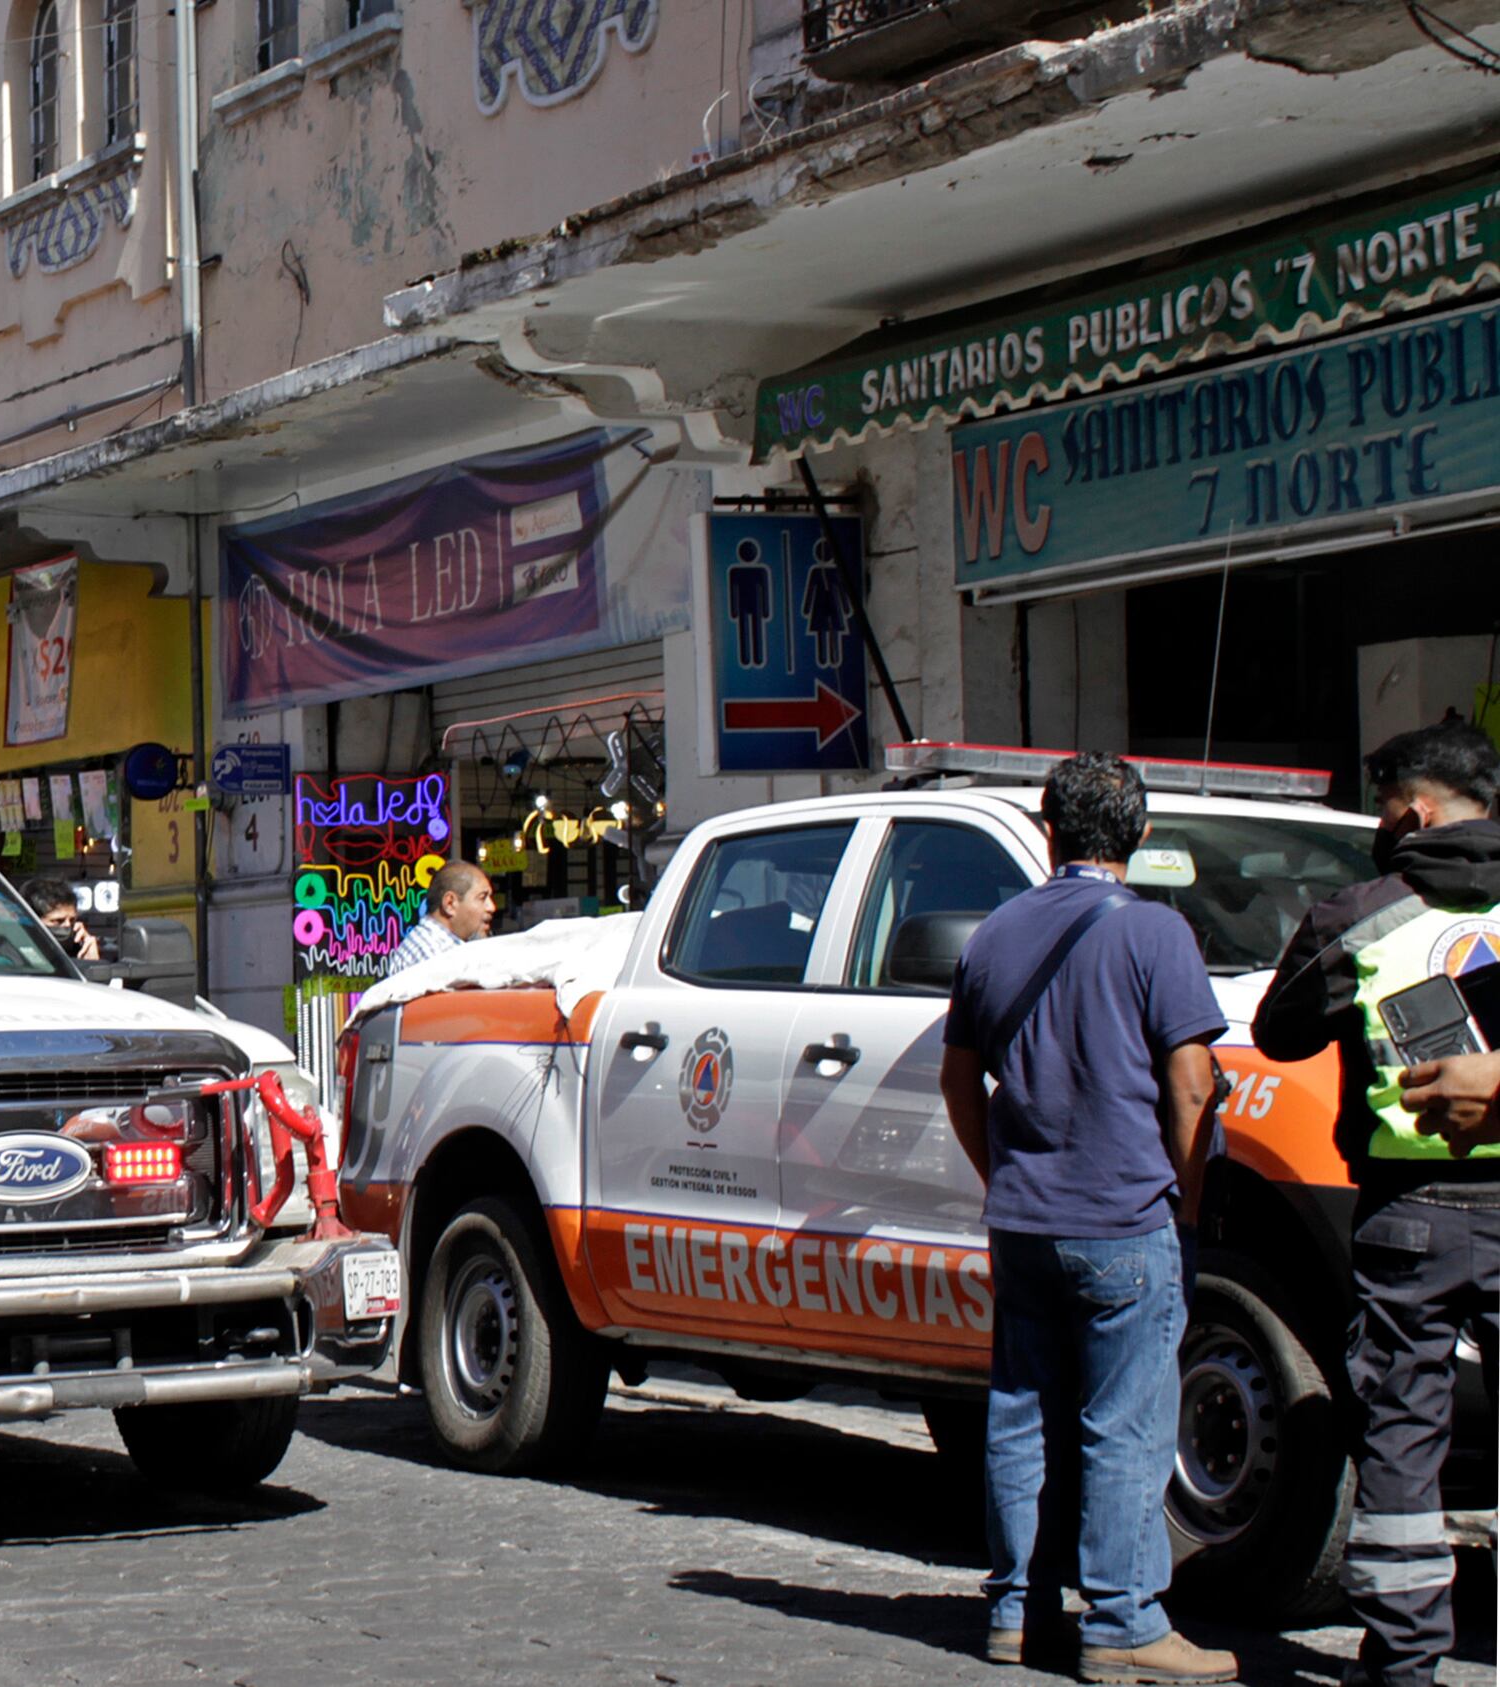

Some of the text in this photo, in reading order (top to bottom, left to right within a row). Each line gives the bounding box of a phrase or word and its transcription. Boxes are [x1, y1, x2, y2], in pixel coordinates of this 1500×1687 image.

[861, 326, 1044, 415] SANITARIOS
[1068, 268, 1254, 363] PUBLICOS
[777, 385, 825, 435] WC
[1061, 353, 1327, 486] SANITARIOS
[953, 431, 1050, 564] WC
[1188, 466, 1219, 537] 7
[286, 553, 384, 648] HOLA
[409, 527, 483, 623] LED
[168, 820, 181, 865] 3
[245, 812, 260, 852] 4
[681, 1181, 714, 1194] INTEGRAL
[716, 1184, 725, 1195] DE
[726, 1185, 758, 1198] RIESGOS
[712, 1169, 731, 1182] CIVIL
[732, 1172, 738, 1182] Y
[624, 1223, 994, 1333] EMERGENCIAS
